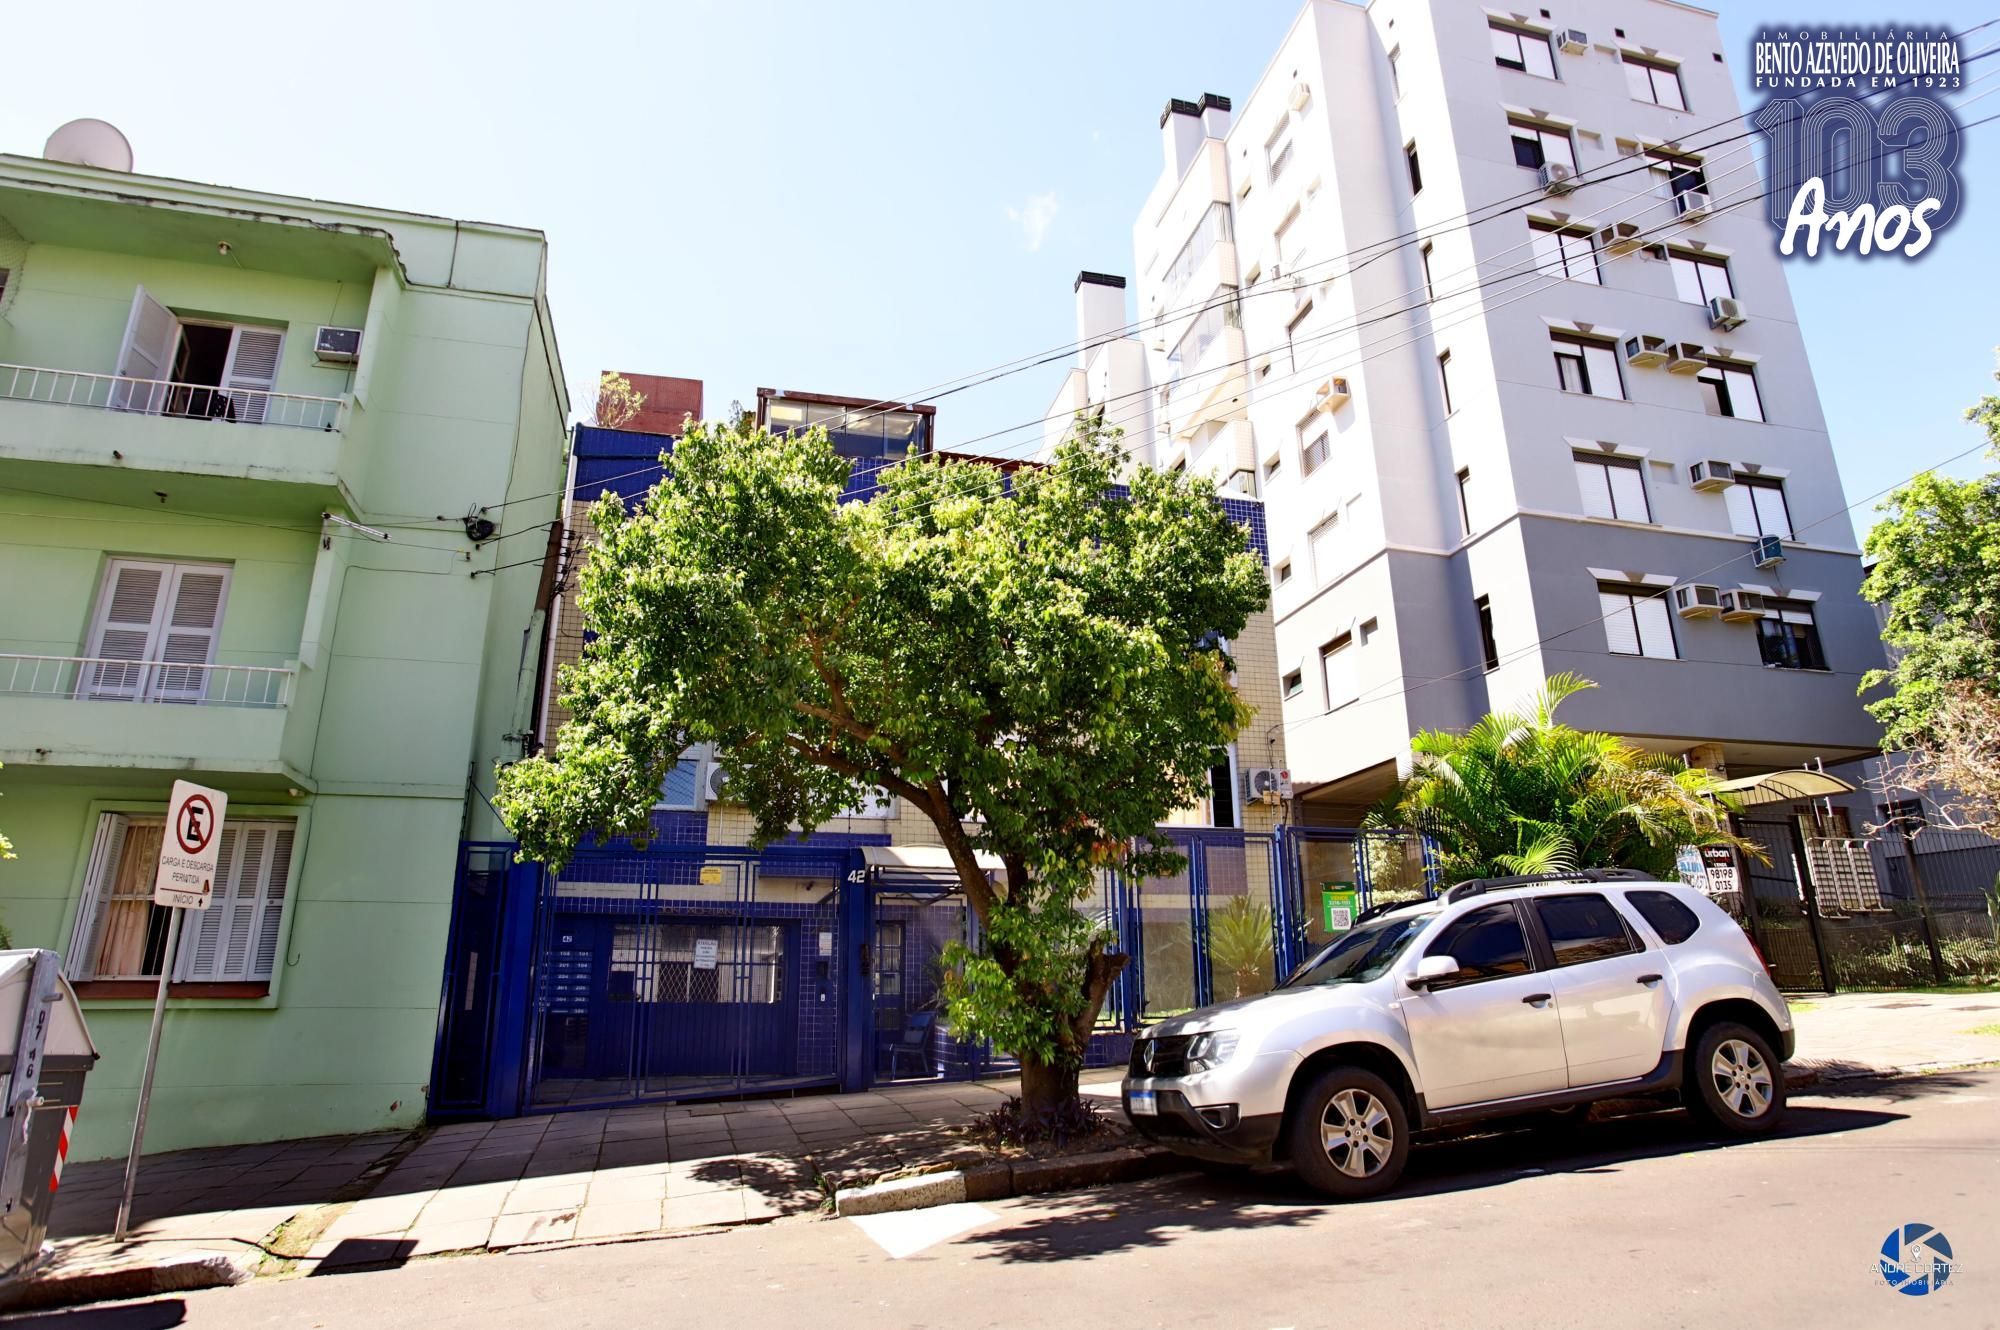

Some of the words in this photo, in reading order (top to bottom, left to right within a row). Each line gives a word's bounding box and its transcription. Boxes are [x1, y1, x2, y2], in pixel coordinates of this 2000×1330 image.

[162, 856, 181, 868] CARGA
[186, 860, 214, 872] DESCARGA
[172, 872, 200, 884] PERMITIDA
[848, 870, 866, 883] 42
[1710, 868, 1733, 879] 98198
[1715, 880, 1733, 891] 0135
[173, 892, 194, 905] INÍCIO
